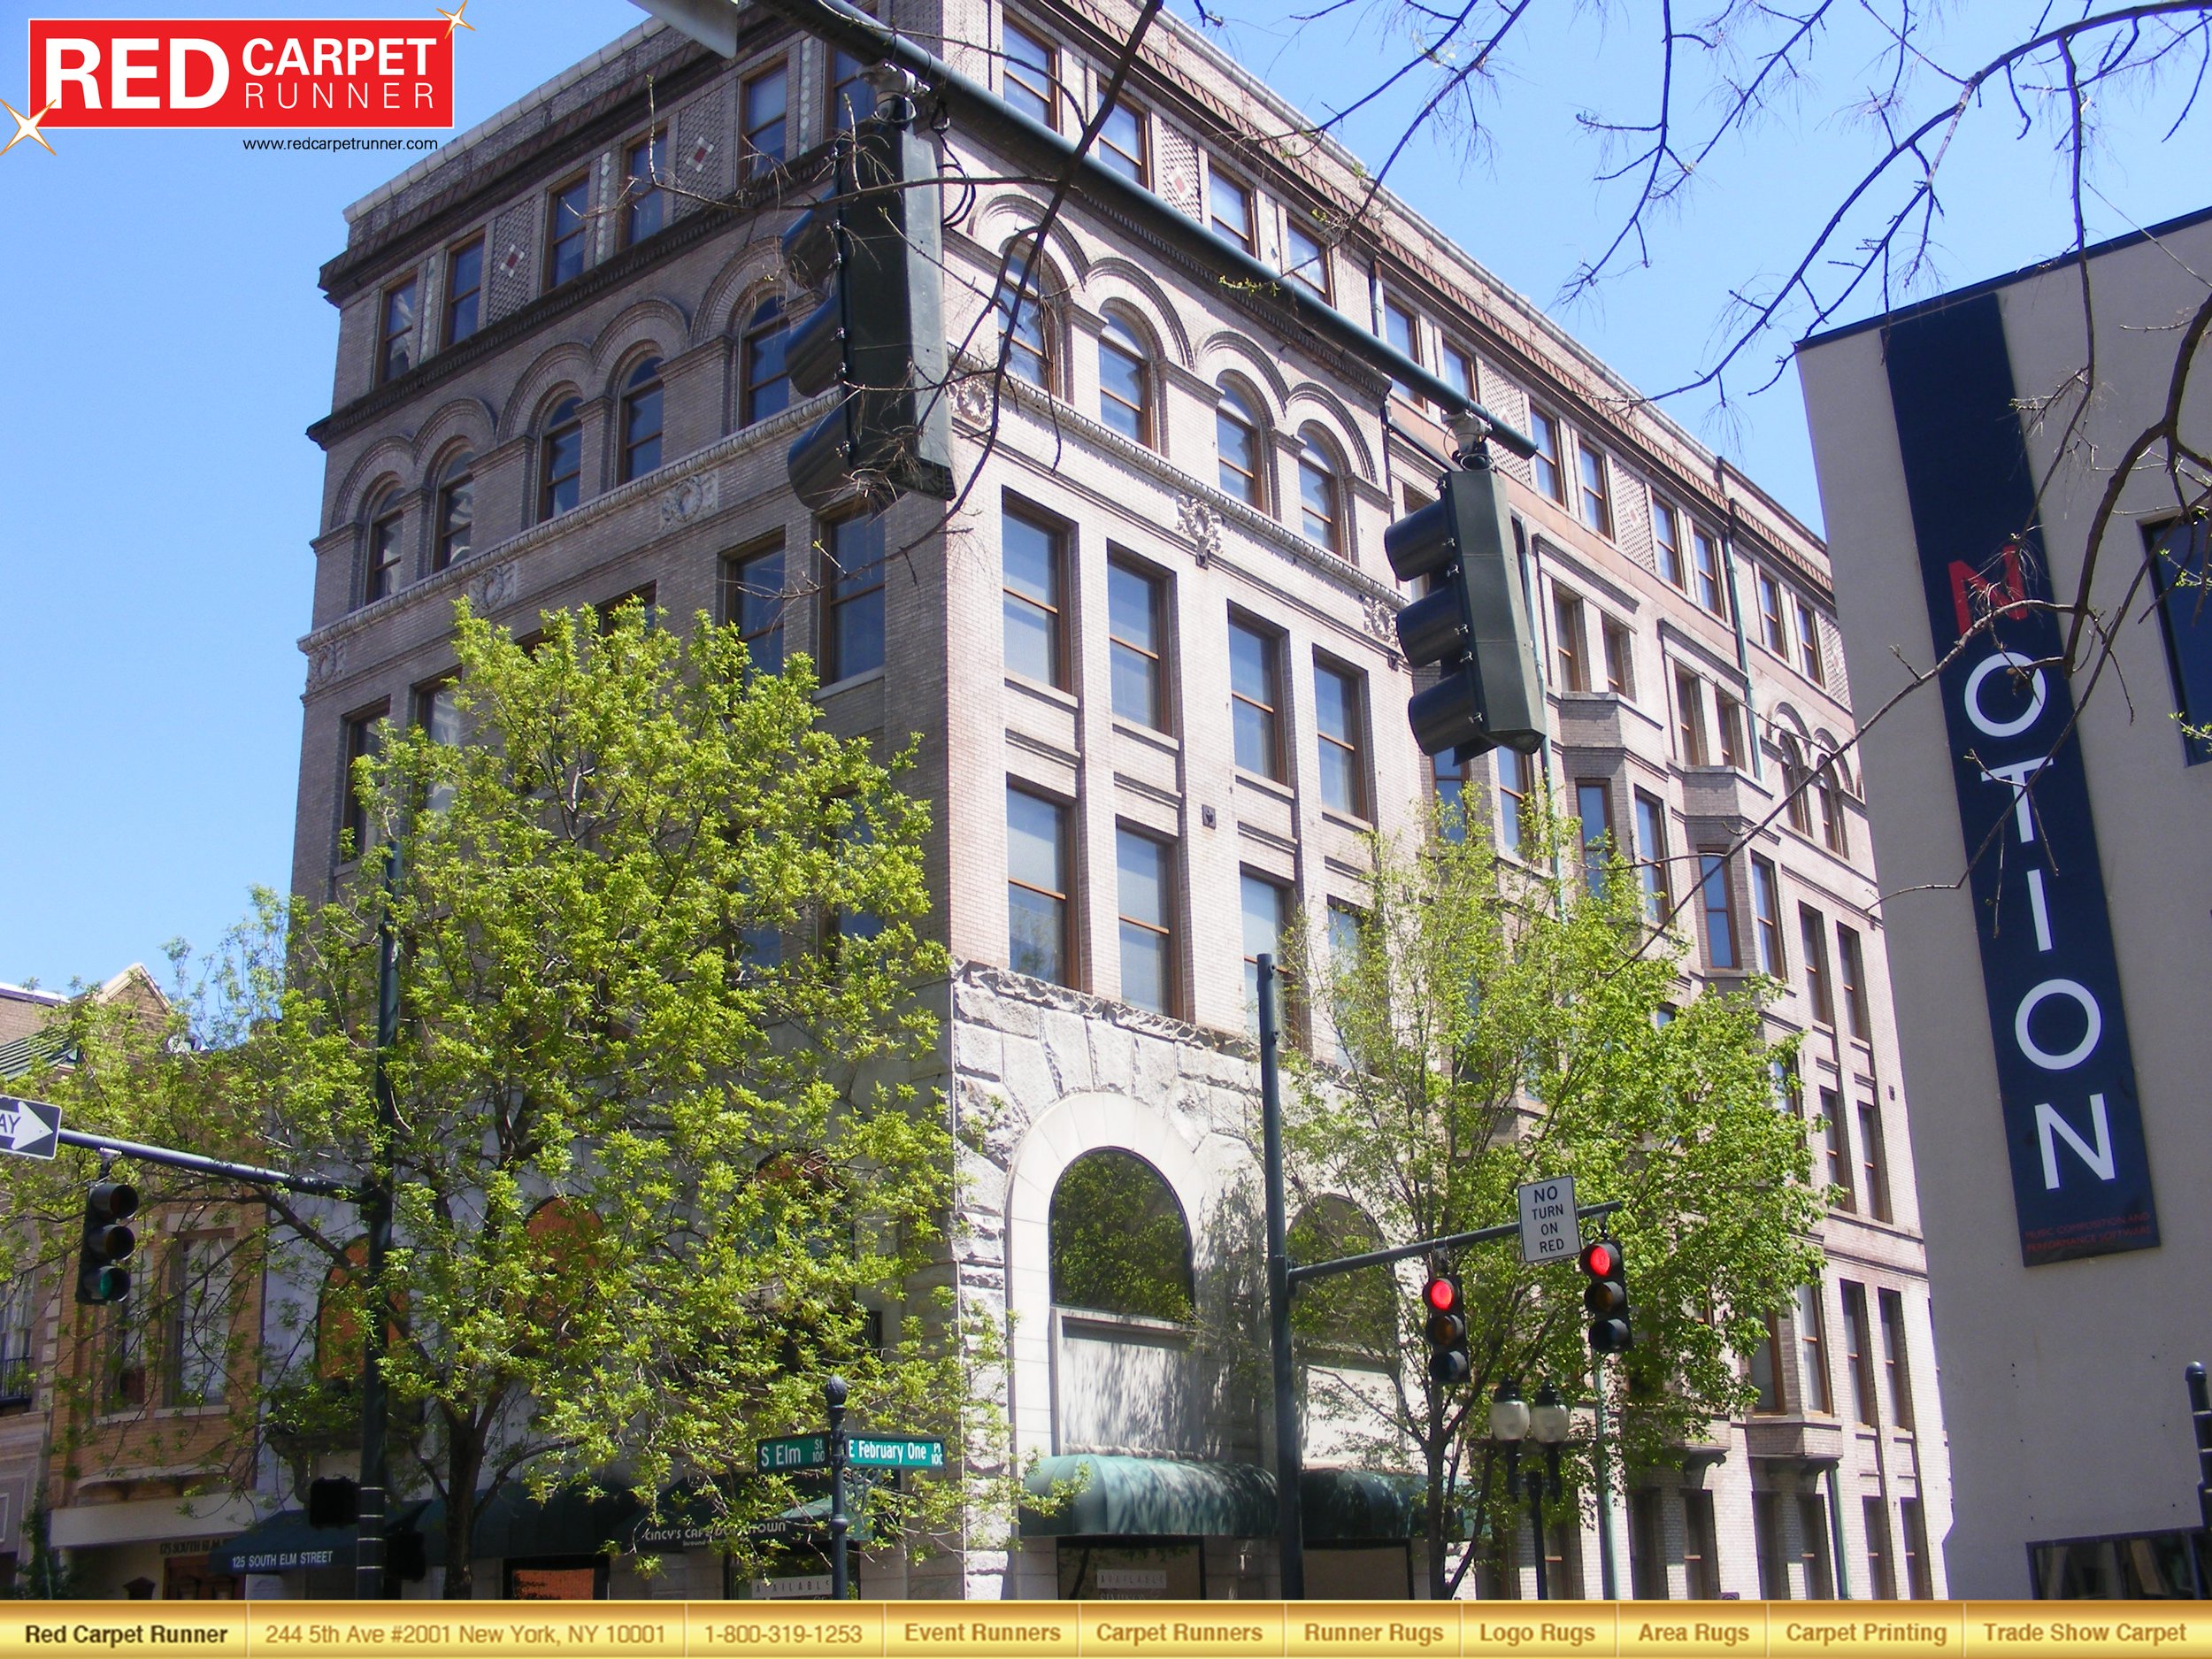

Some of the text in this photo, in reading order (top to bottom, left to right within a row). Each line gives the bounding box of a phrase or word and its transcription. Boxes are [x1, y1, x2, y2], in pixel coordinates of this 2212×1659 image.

[1948, 545, 2116, 1190] NOTION
[1534, 1186, 1557, 1203] NO
[1532, 1204, 1563, 1220] TURN
[1540, 1222, 1558, 1235] ON
[1540, 1239, 1564, 1253] RED
[760, 1439, 823, 1466] S Elm St
[812, 1449, 825, 1463] 100
[848, 1438, 941, 1463] E February One Pl
[644, 1529, 681, 1541] CINCY'S
[685, 1527, 712, 1539] CAF
[232, 1550, 334, 1569] 125 SOUTH ELM STREET
